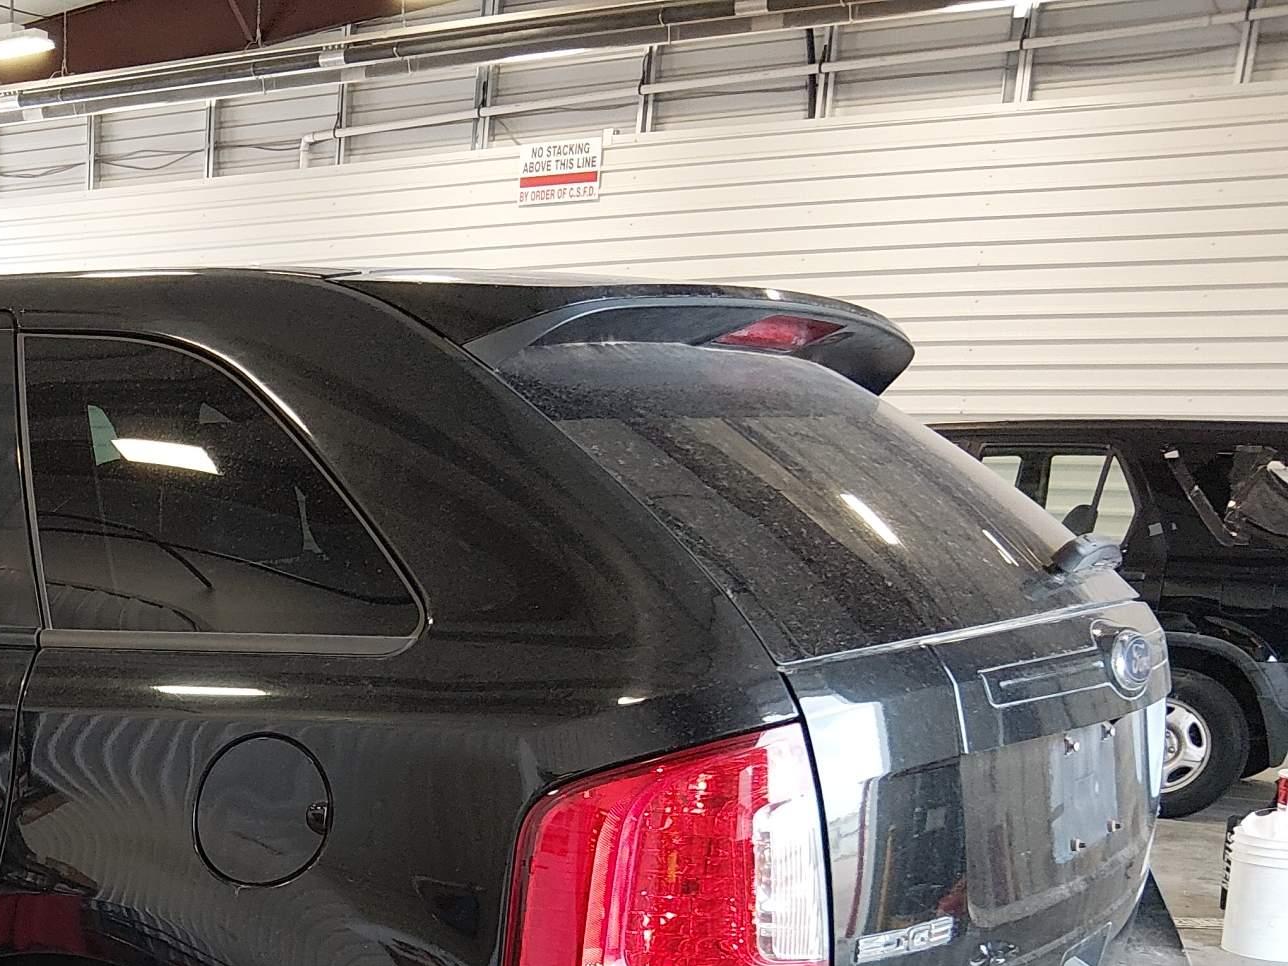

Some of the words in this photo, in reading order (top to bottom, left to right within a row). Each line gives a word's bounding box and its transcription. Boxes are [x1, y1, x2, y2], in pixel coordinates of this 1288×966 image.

[531, 147, 544, 159] NO
[546, 142, 590, 158] STACKING
[522, 160, 552, 174] ABOVE
[555, 158, 574, 171] THIS
[576, 156, 597, 169] LINE
[519, 191, 529, 202] BY
[531, 189, 556, 201] ORDER
[557, 188, 567, 199] OF
[569, 186, 596, 198] C.S.F.D.
